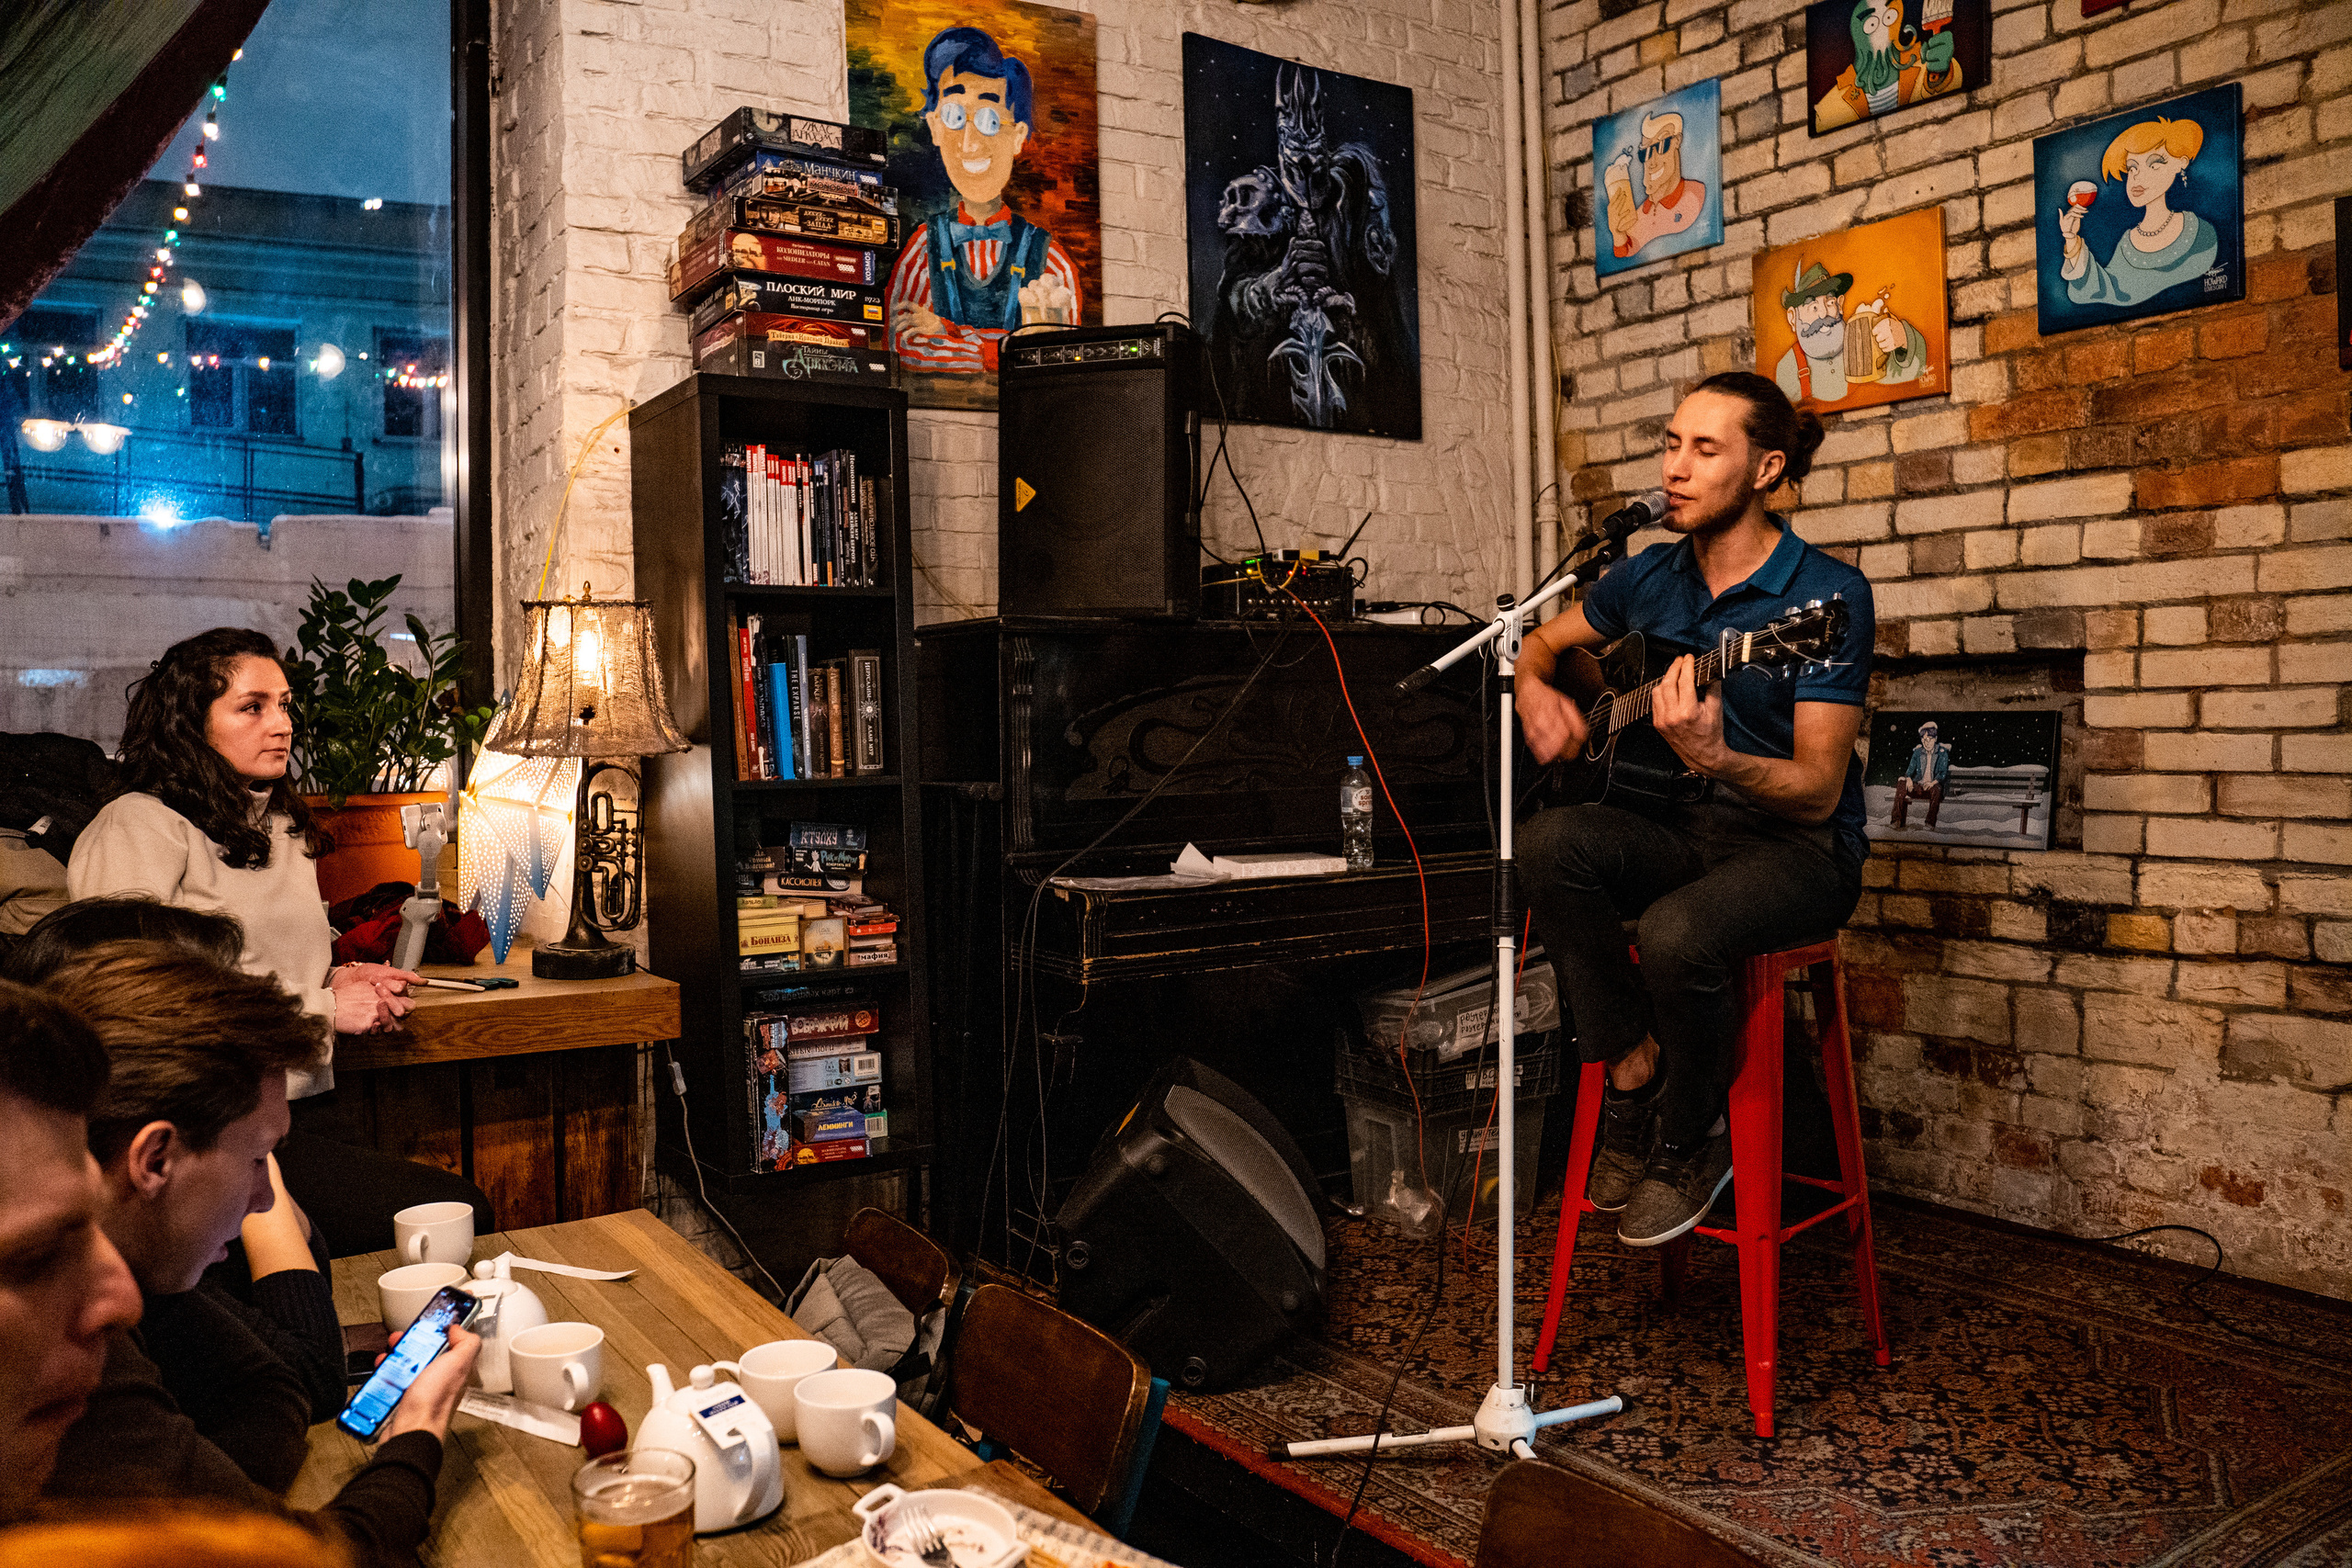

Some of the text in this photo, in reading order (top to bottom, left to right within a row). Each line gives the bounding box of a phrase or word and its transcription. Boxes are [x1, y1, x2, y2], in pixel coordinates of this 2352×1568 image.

[802, 121, 832, 135] УЖАС
[808, 181, 855, 194] MONOPOLY
[776, 246, 830, 259] КОЛОНИЗАТОРЫ
[2203, 275, 2228, 287] HOWARD
[765, 281, 857, 299] ПЛОСКИЙ МИР
[787, 296, 837, 306] АНК-МОРПОРК
[1824, 609, 1836, 643] Fender
[792, 686, 800, 720] EXPANSE
[800, 831, 838, 846] КТУЛХУ
[780, 876, 822, 887] КАССИОПЕЯ
[860, 953, 888, 961] мафия
[818, 1122, 854, 1132] ЛЕММИНГИ
